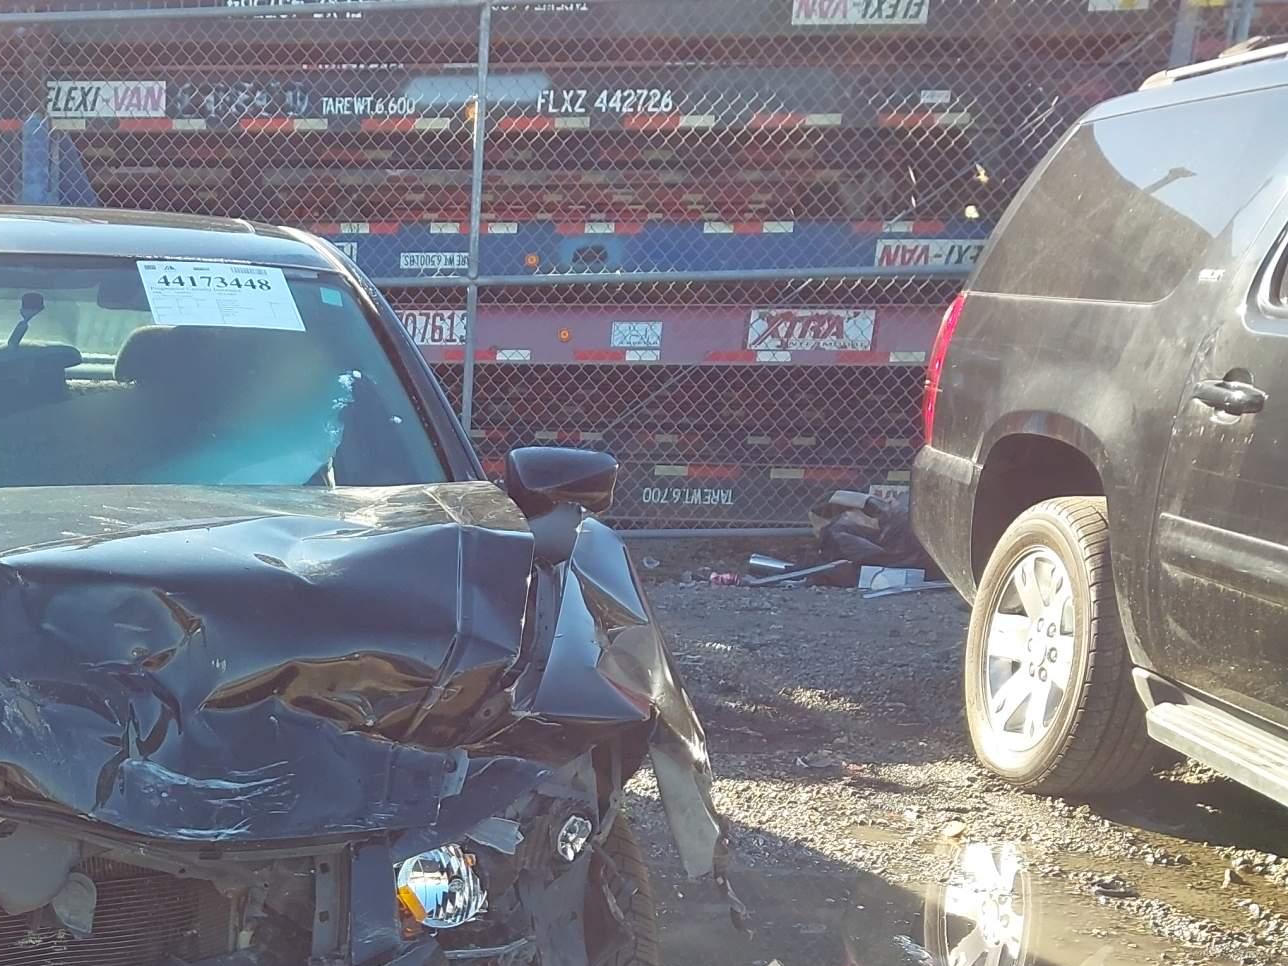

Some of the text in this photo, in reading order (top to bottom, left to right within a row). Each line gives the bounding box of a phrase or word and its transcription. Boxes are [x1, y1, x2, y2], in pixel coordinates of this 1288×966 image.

[536, 88, 674, 113] FLXZ 442726
[157, 274, 272, 291] 44173448
